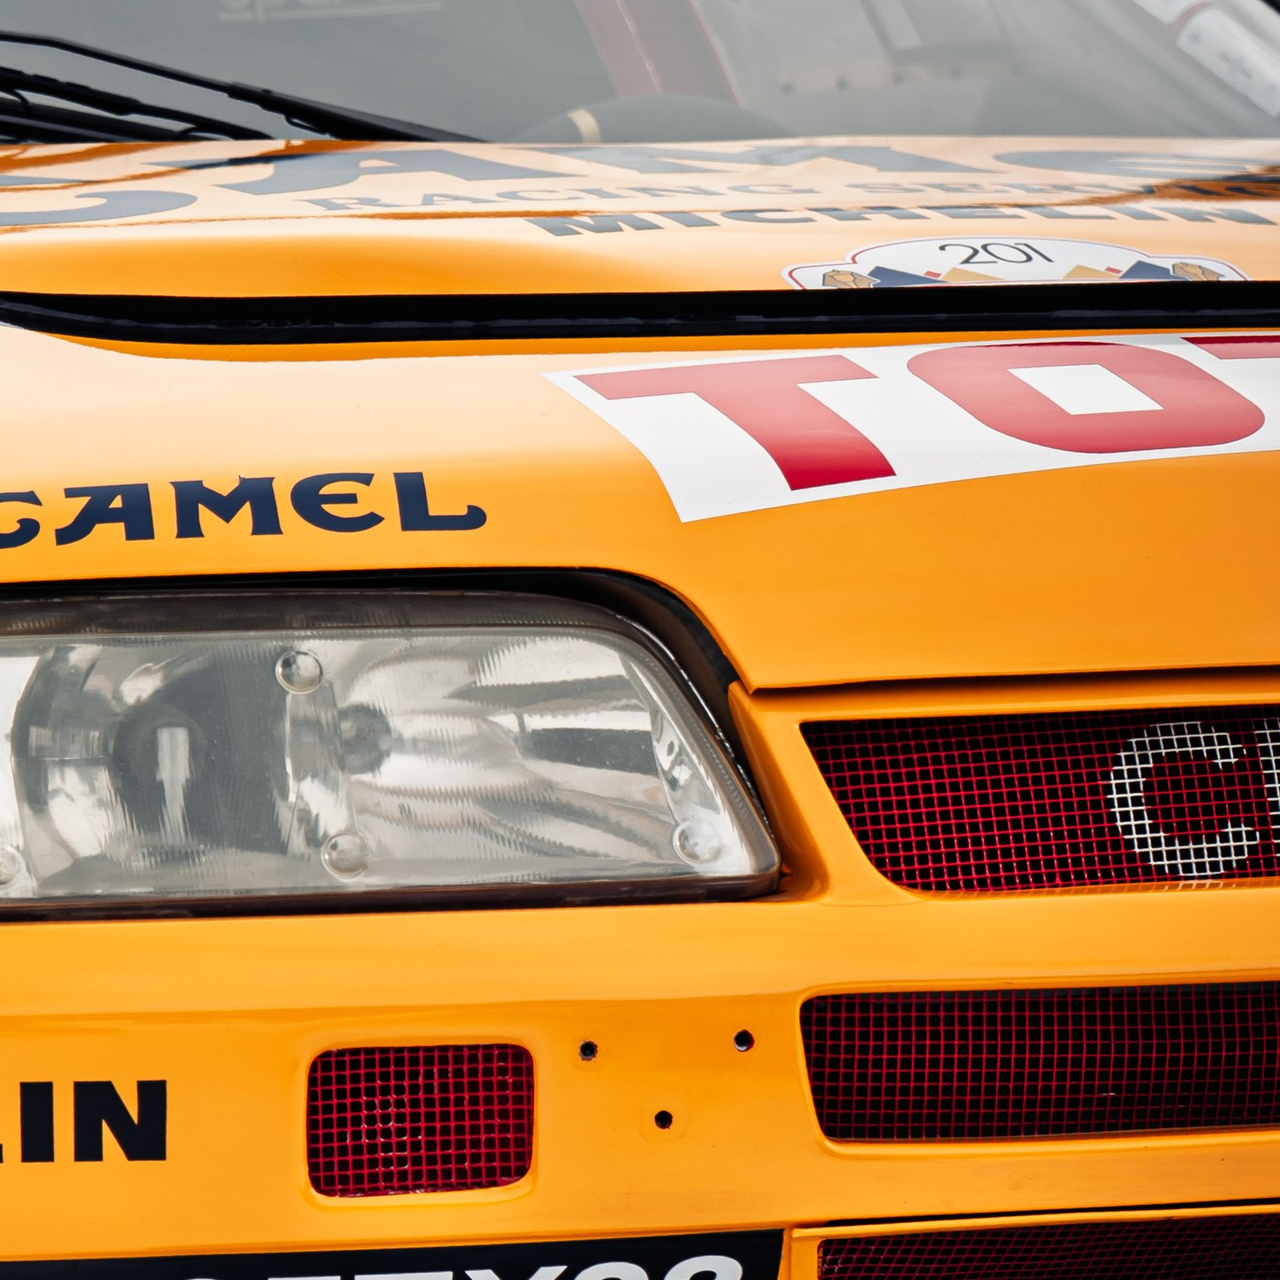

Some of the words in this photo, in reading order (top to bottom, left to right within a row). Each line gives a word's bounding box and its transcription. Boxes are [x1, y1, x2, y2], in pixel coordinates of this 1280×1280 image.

[294, 184, 823, 211] RACING
[526, 204, 1279, 237] MICHELIN
[938, 242, 1054, 266] 201
[573, 335, 1280, 492] TO
